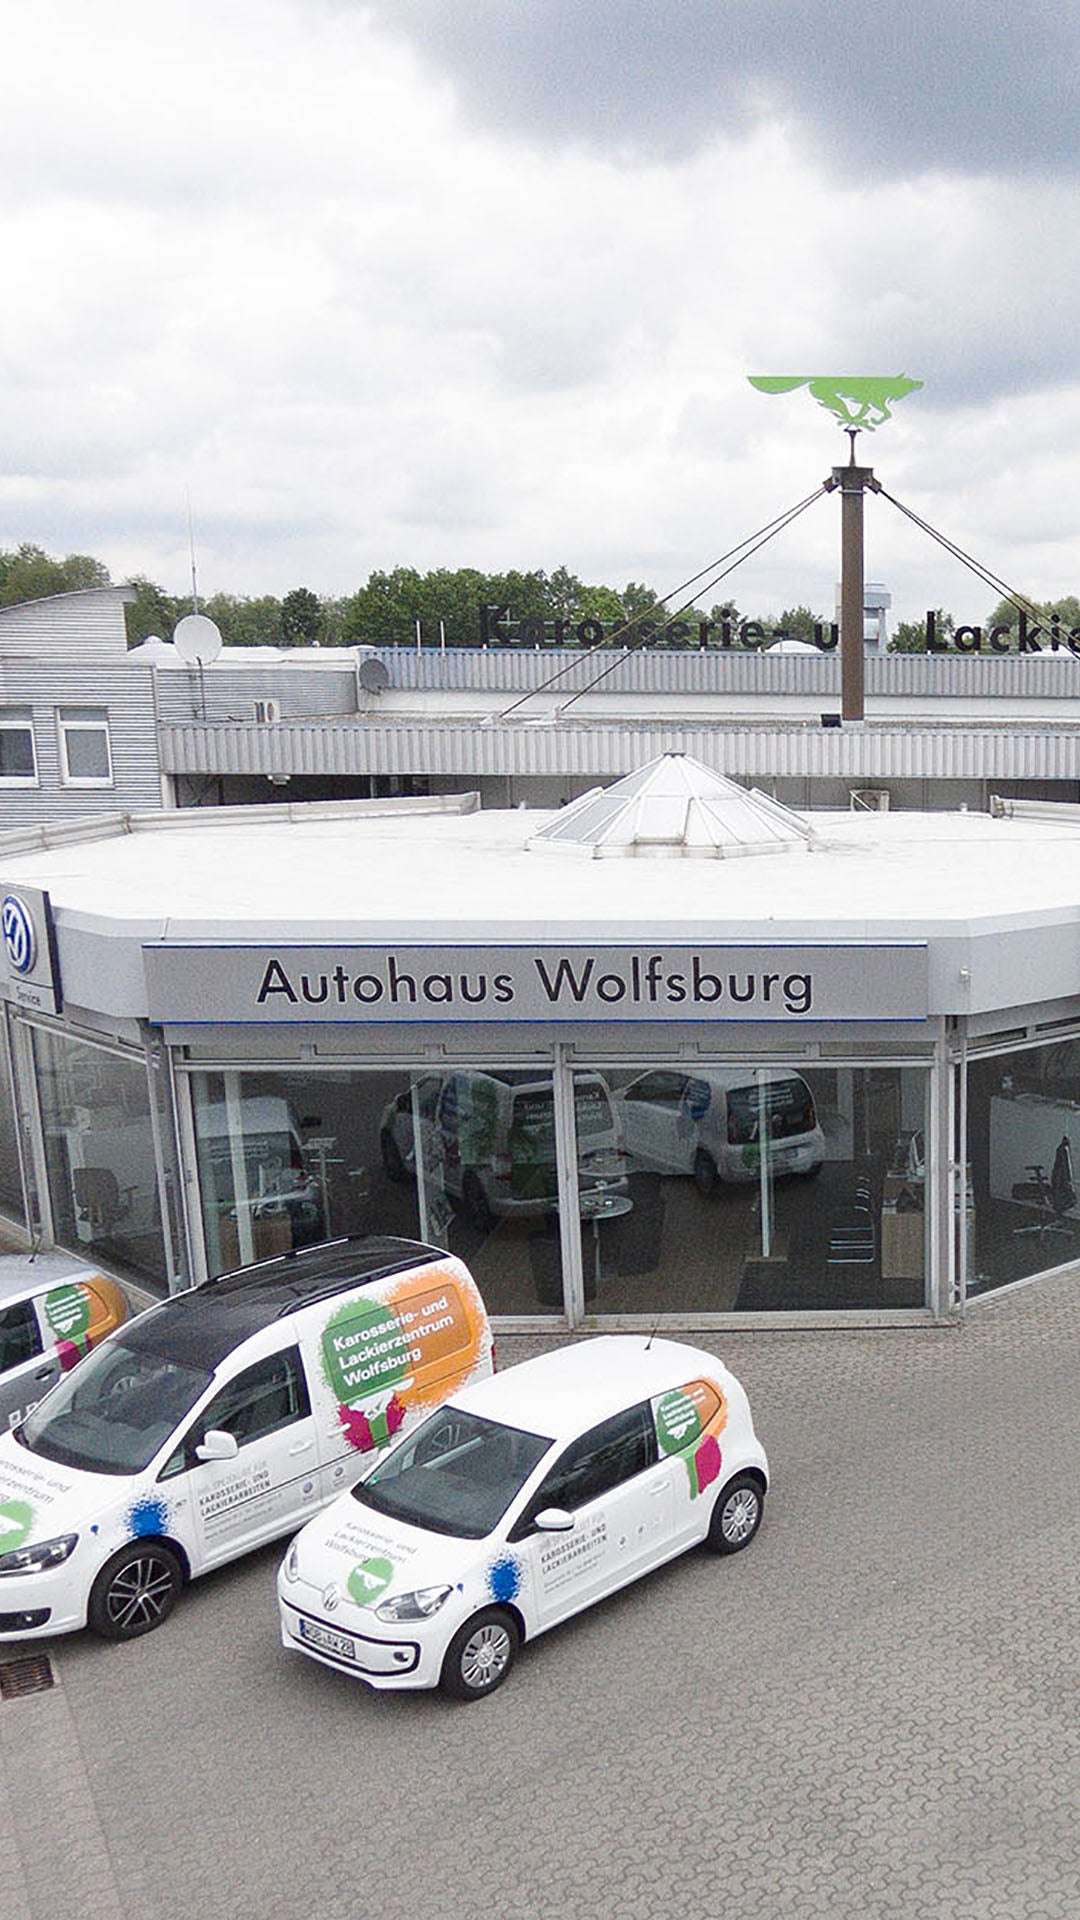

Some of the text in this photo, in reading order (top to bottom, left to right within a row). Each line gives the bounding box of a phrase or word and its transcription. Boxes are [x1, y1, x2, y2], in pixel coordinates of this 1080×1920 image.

[256, 956, 812, 1014] Autohaus Wolfsburg
[333, 1296, 448, 1352] Karosserie- und
[338, 1315, 454, 1370] Lackierzentrum
[343, 1347, 422, 1387] Wolfsburg
